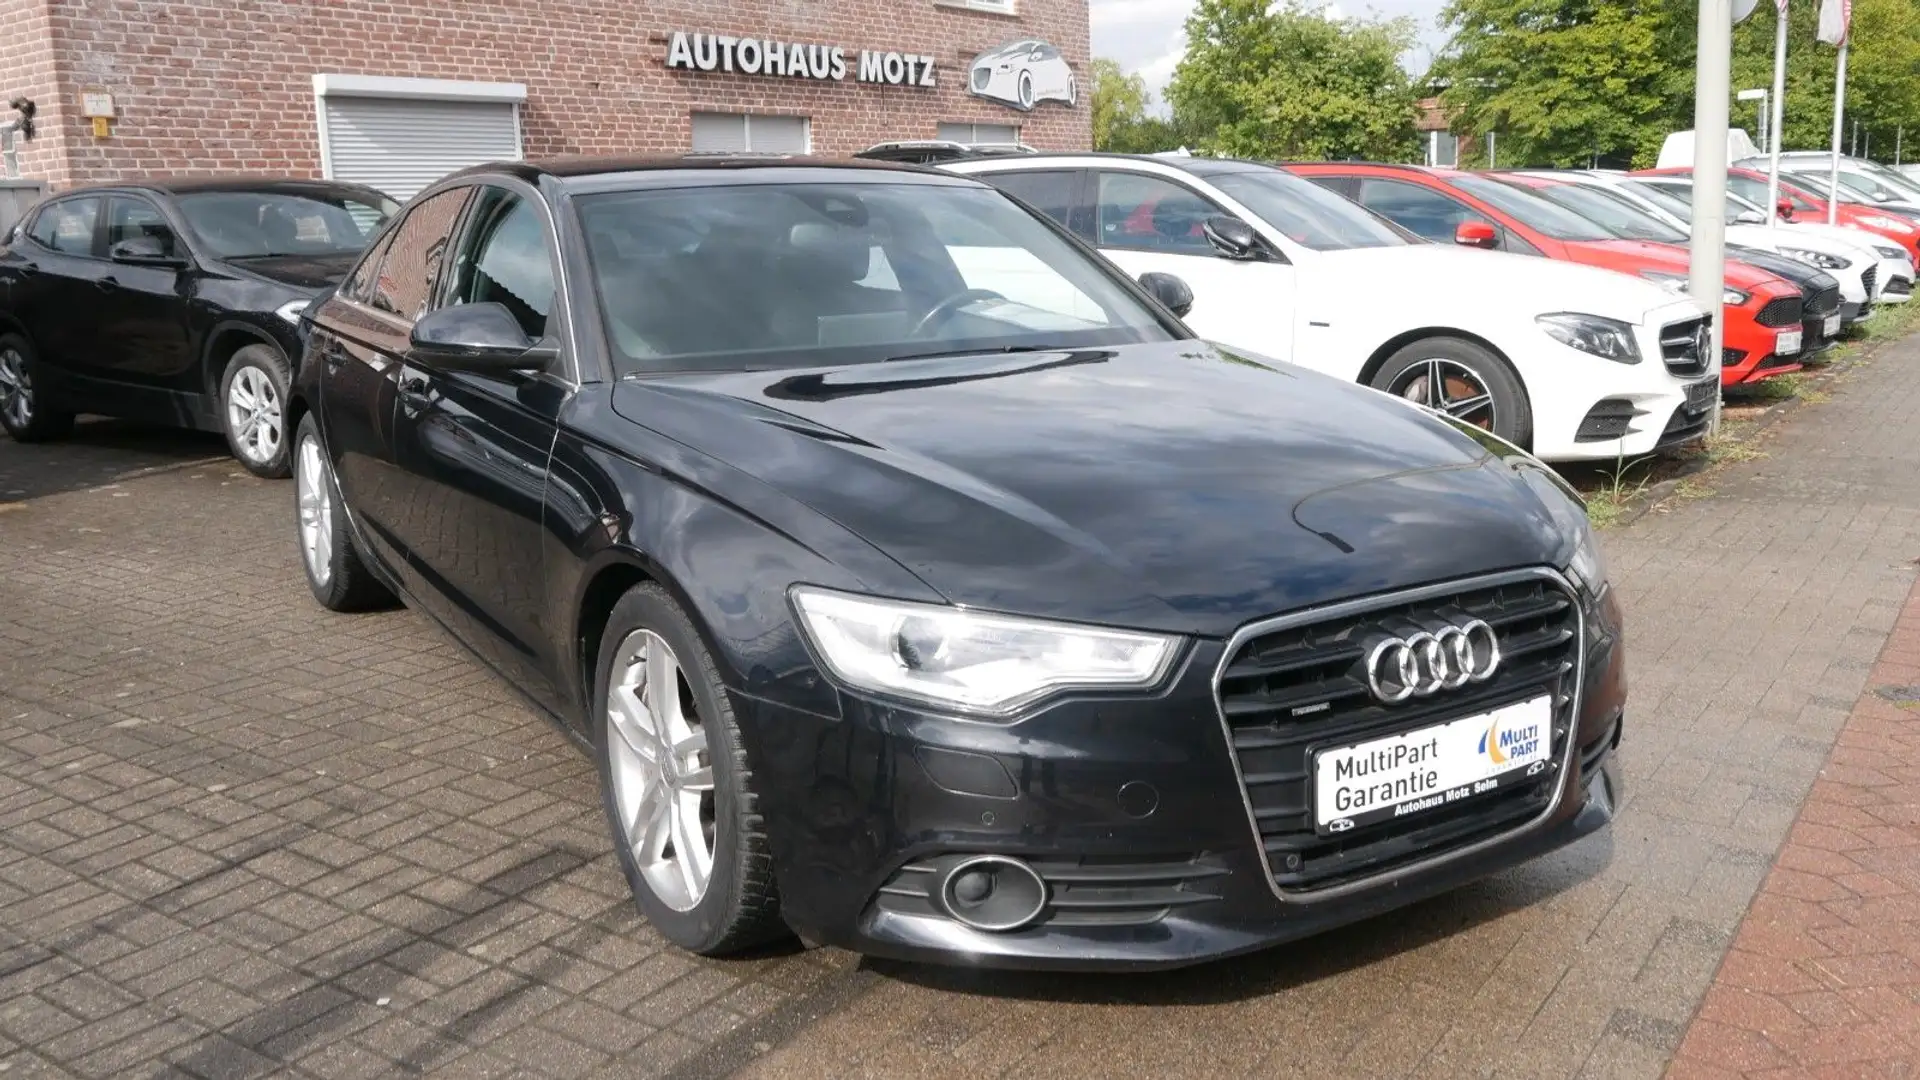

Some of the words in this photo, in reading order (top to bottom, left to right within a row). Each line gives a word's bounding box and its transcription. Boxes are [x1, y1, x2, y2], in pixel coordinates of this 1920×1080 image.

[667, 31, 846, 81] AUTOHAUS
[858, 49, 936, 87] MOTZ
[1500, 724, 1538, 748] MULTI
[1510, 739, 1539, 759] PART
[1335, 737, 1438, 782] MultiPart
[1335, 768, 1438, 812] Garantie
[1394, 789, 1444, 816] Autohaus
[1446, 785, 1470, 804] Motz
[1474, 777, 1498, 794] Selm
